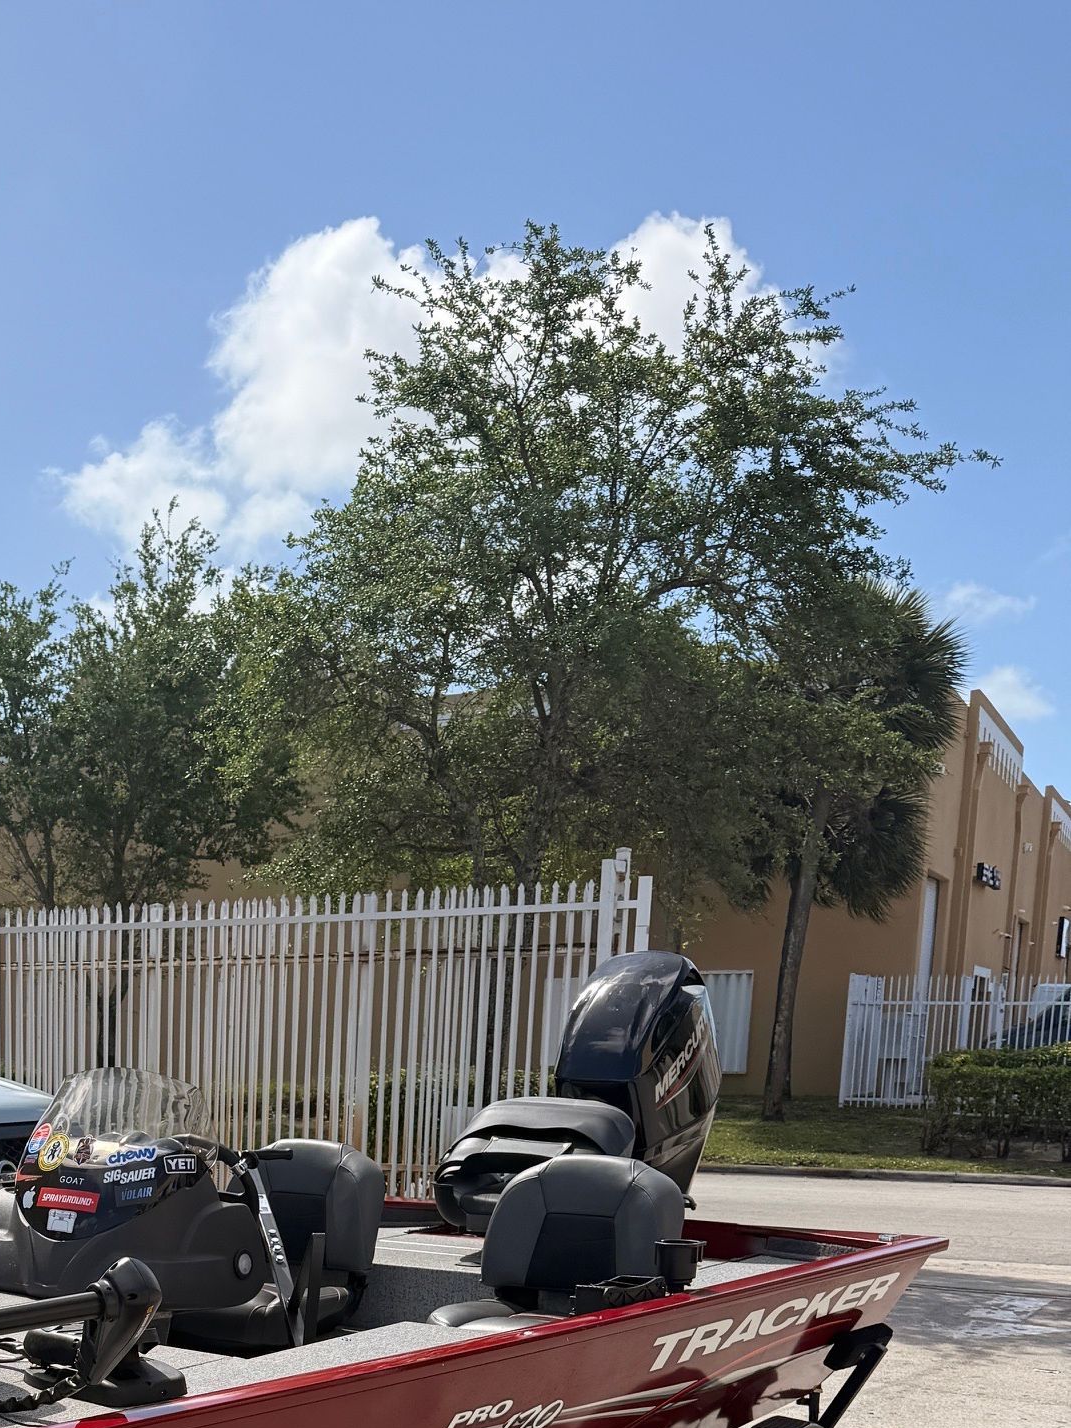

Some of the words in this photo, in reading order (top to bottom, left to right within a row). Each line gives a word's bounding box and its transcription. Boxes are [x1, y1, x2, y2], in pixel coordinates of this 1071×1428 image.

[107, 1147, 157, 1165] chewy
[167, 1158, 195, 1170] YETI
[59, 1175, 85, 1186] GOAT
[103, 1168, 122, 1184] SIG
[119, 1167, 157, 1184] SAUER
[649, 1271, 900, 1372] TRACKER
